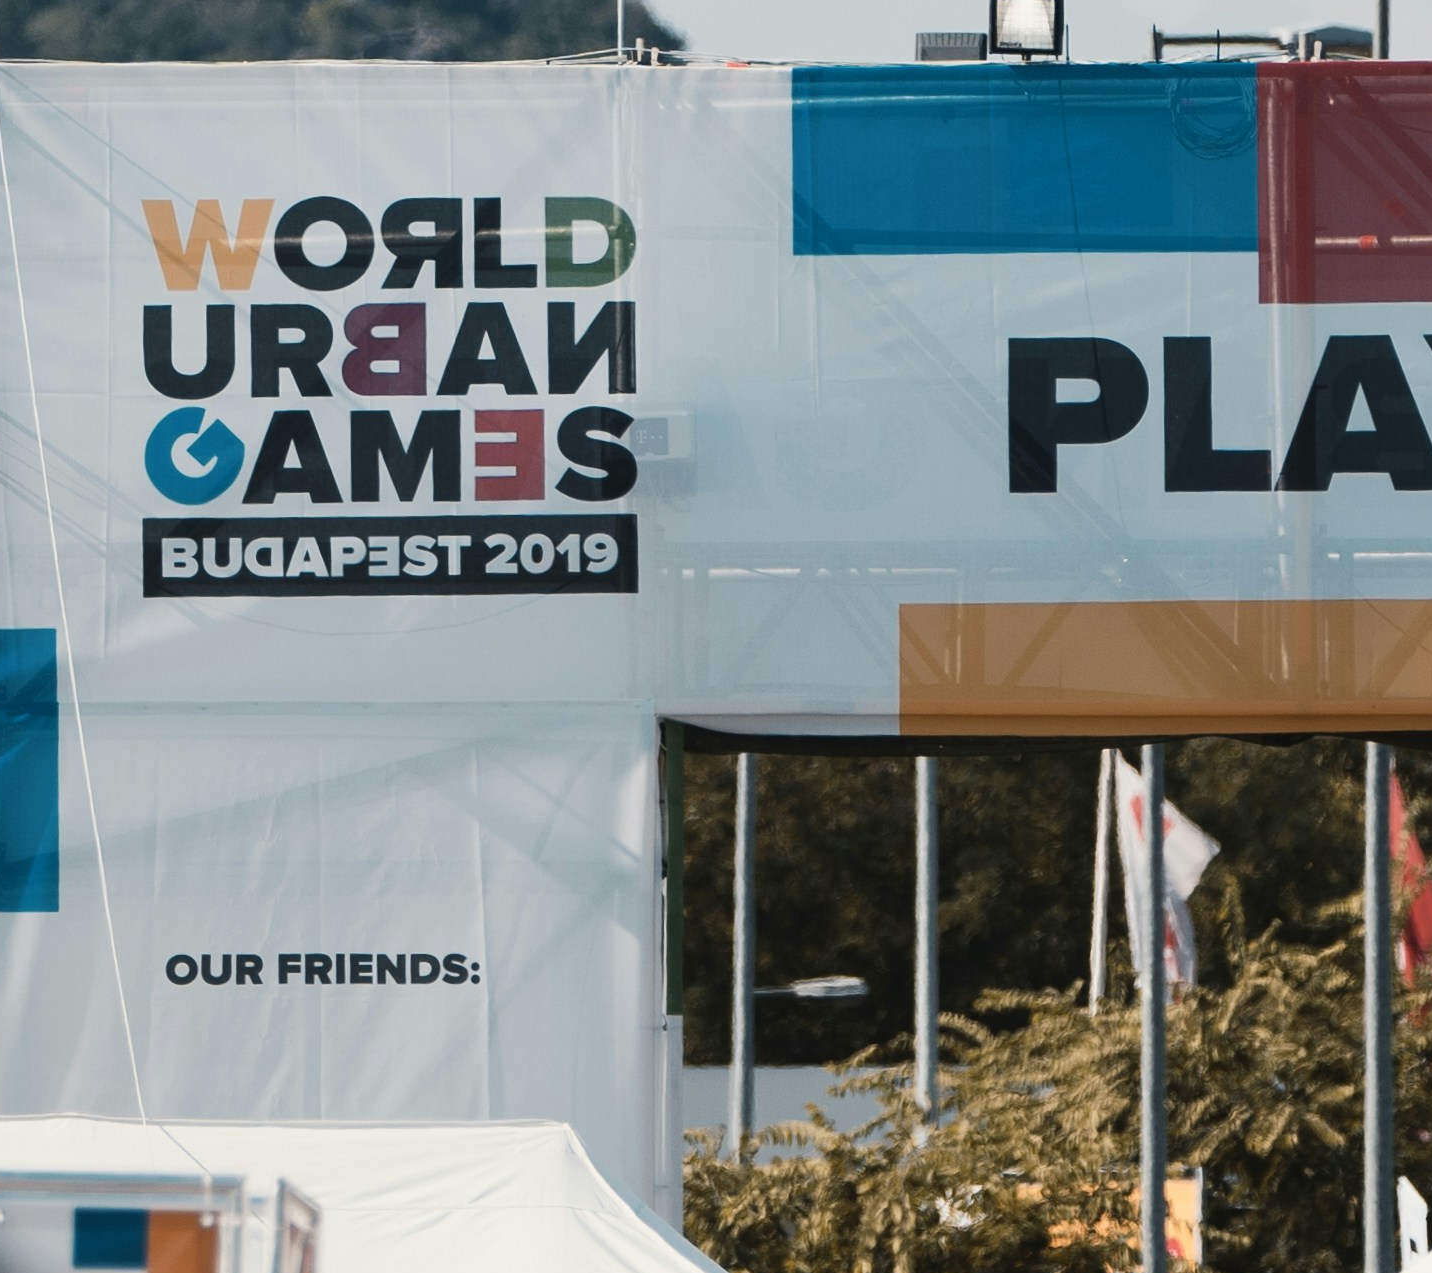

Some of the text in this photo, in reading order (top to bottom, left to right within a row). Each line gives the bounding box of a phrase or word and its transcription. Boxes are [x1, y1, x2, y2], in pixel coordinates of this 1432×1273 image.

[141, 195, 637, 292] WORLD
[142, 301, 636, 399] URBAN
[144, 405, 639, 506] GAMES
[160, 531, 619, 580] BUDAPEST 2019
[165, 951, 482, 986] OUR FRIENDS:
